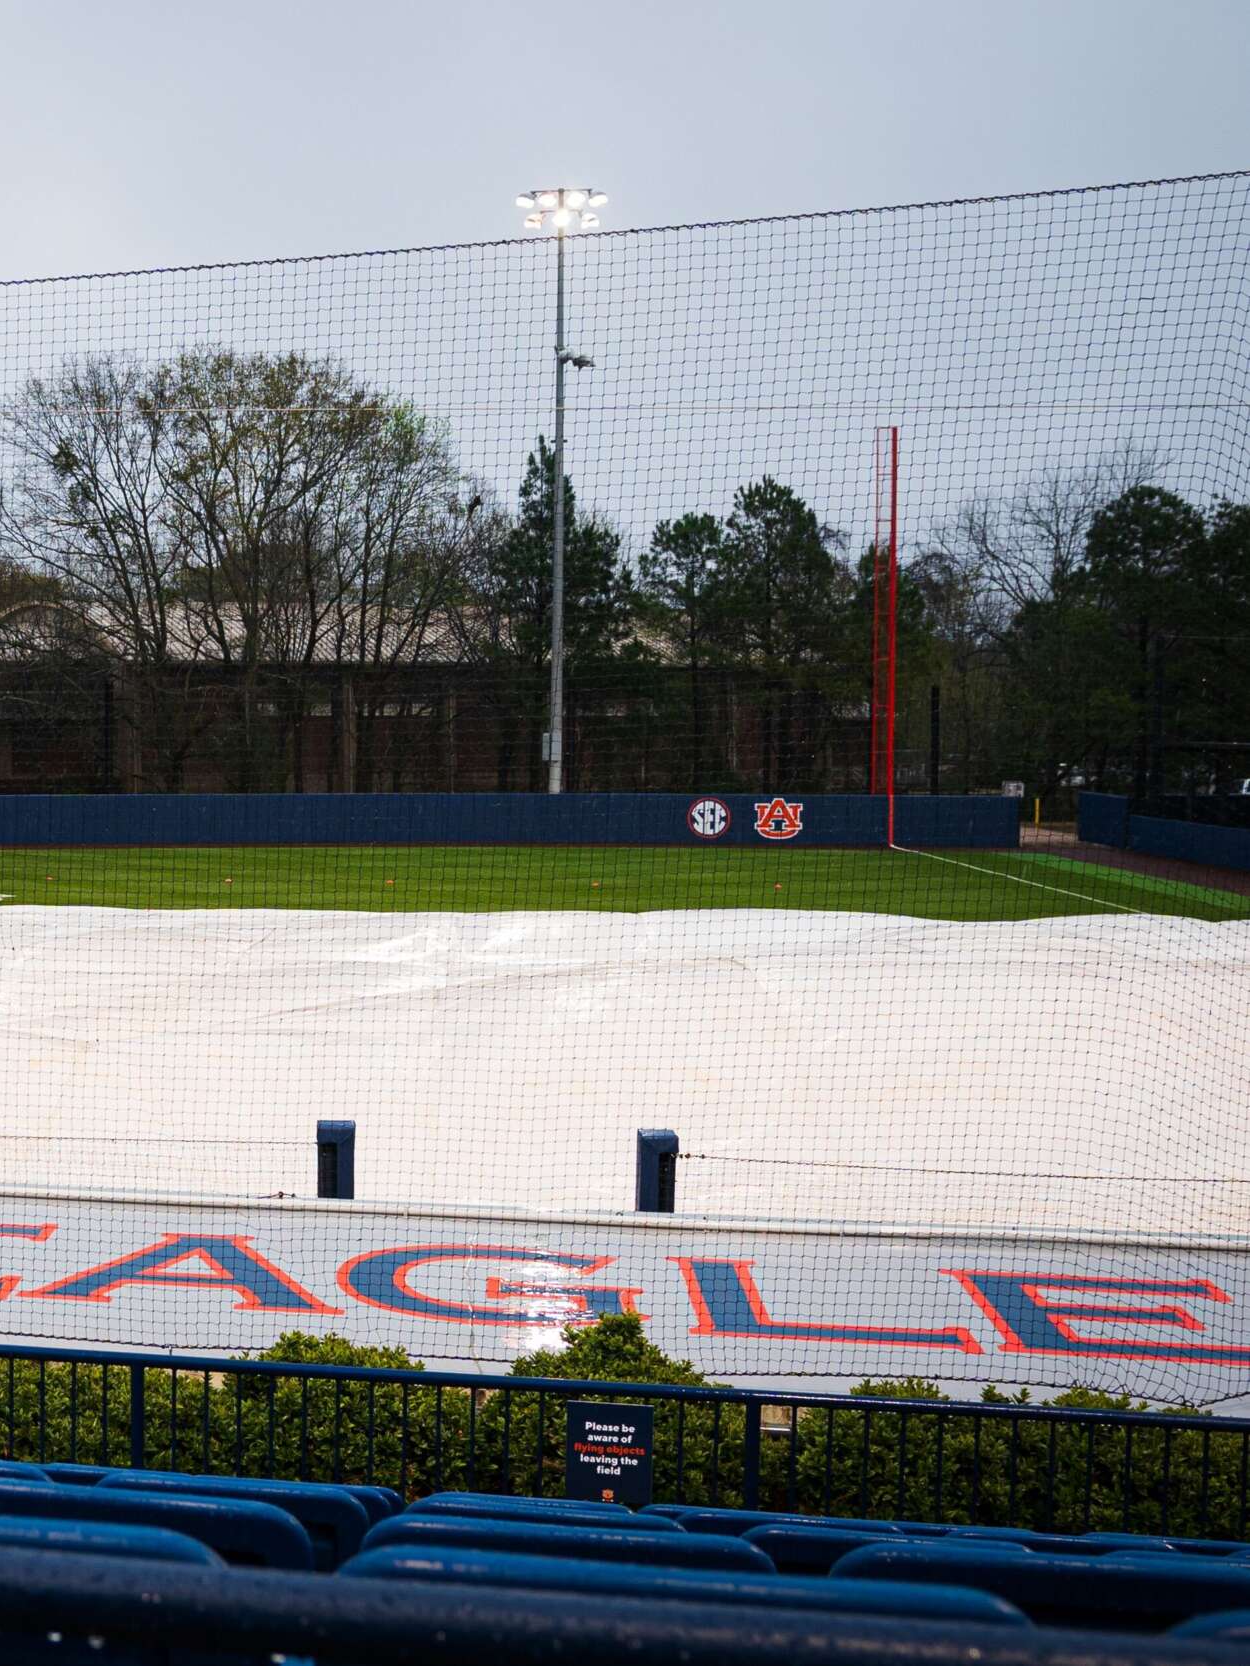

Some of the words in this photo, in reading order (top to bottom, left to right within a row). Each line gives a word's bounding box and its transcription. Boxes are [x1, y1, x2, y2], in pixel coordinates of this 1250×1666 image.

[691, 800, 727, 835] SEC
[585, 1421, 620, 1432] Please
[621, 1424, 635, 1433] be
[587, 1434, 619, 1443] aware
[621, 1435, 632, 1444] of
[574, 1442, 604, 1454] flying
[606, 1444, 645, 1456] objects
[580, 1454, 618, 1466] leaving
[620, 1456, 638, 1466] the
[596, 1465, 621, 1475] field
